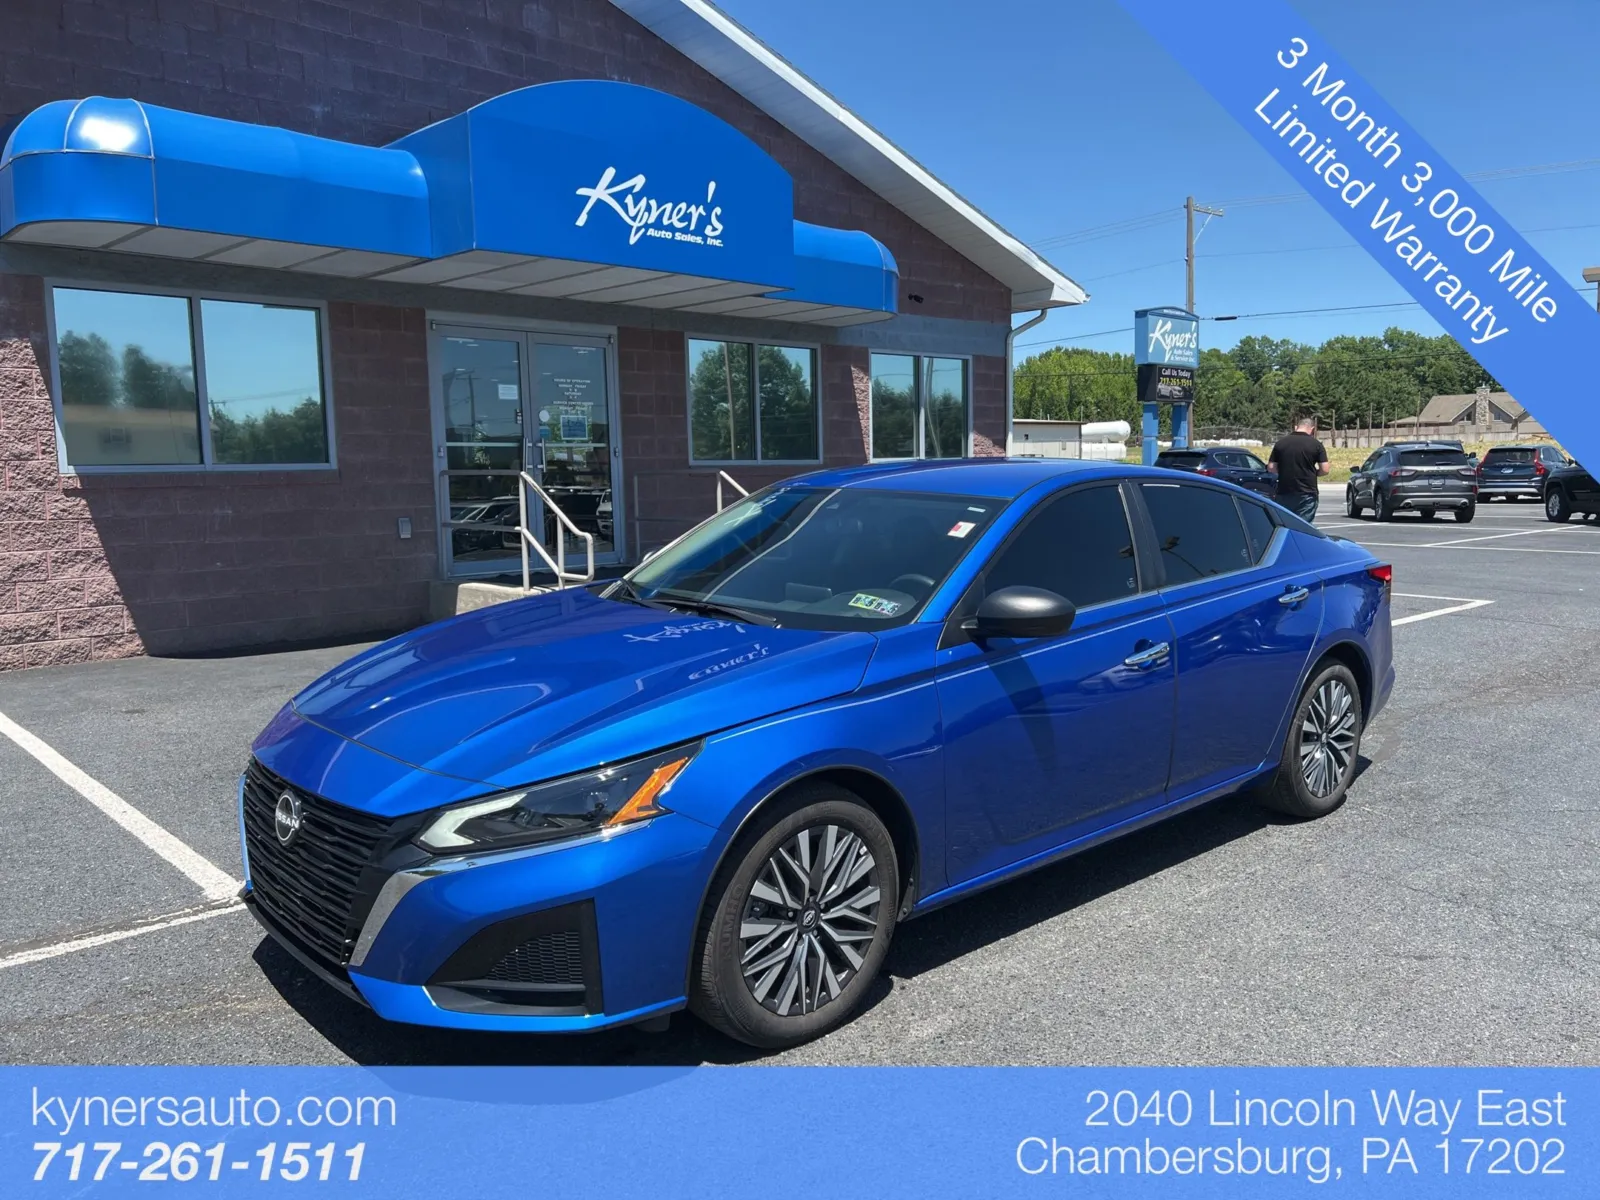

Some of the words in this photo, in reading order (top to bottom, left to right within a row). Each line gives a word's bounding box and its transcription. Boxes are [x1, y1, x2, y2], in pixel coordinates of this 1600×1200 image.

[575, 166, 724, 245] Kyner's
[646, 228, 673, 239] Auto
[674, 232, 704, 245] Sales,
[706, 237, 724, 247] Inc.
[1149, 319, 1197, 363] Kyner's
[1178, 369, 1191, 378] Today
[276, 808, 300, 829] SSAN
